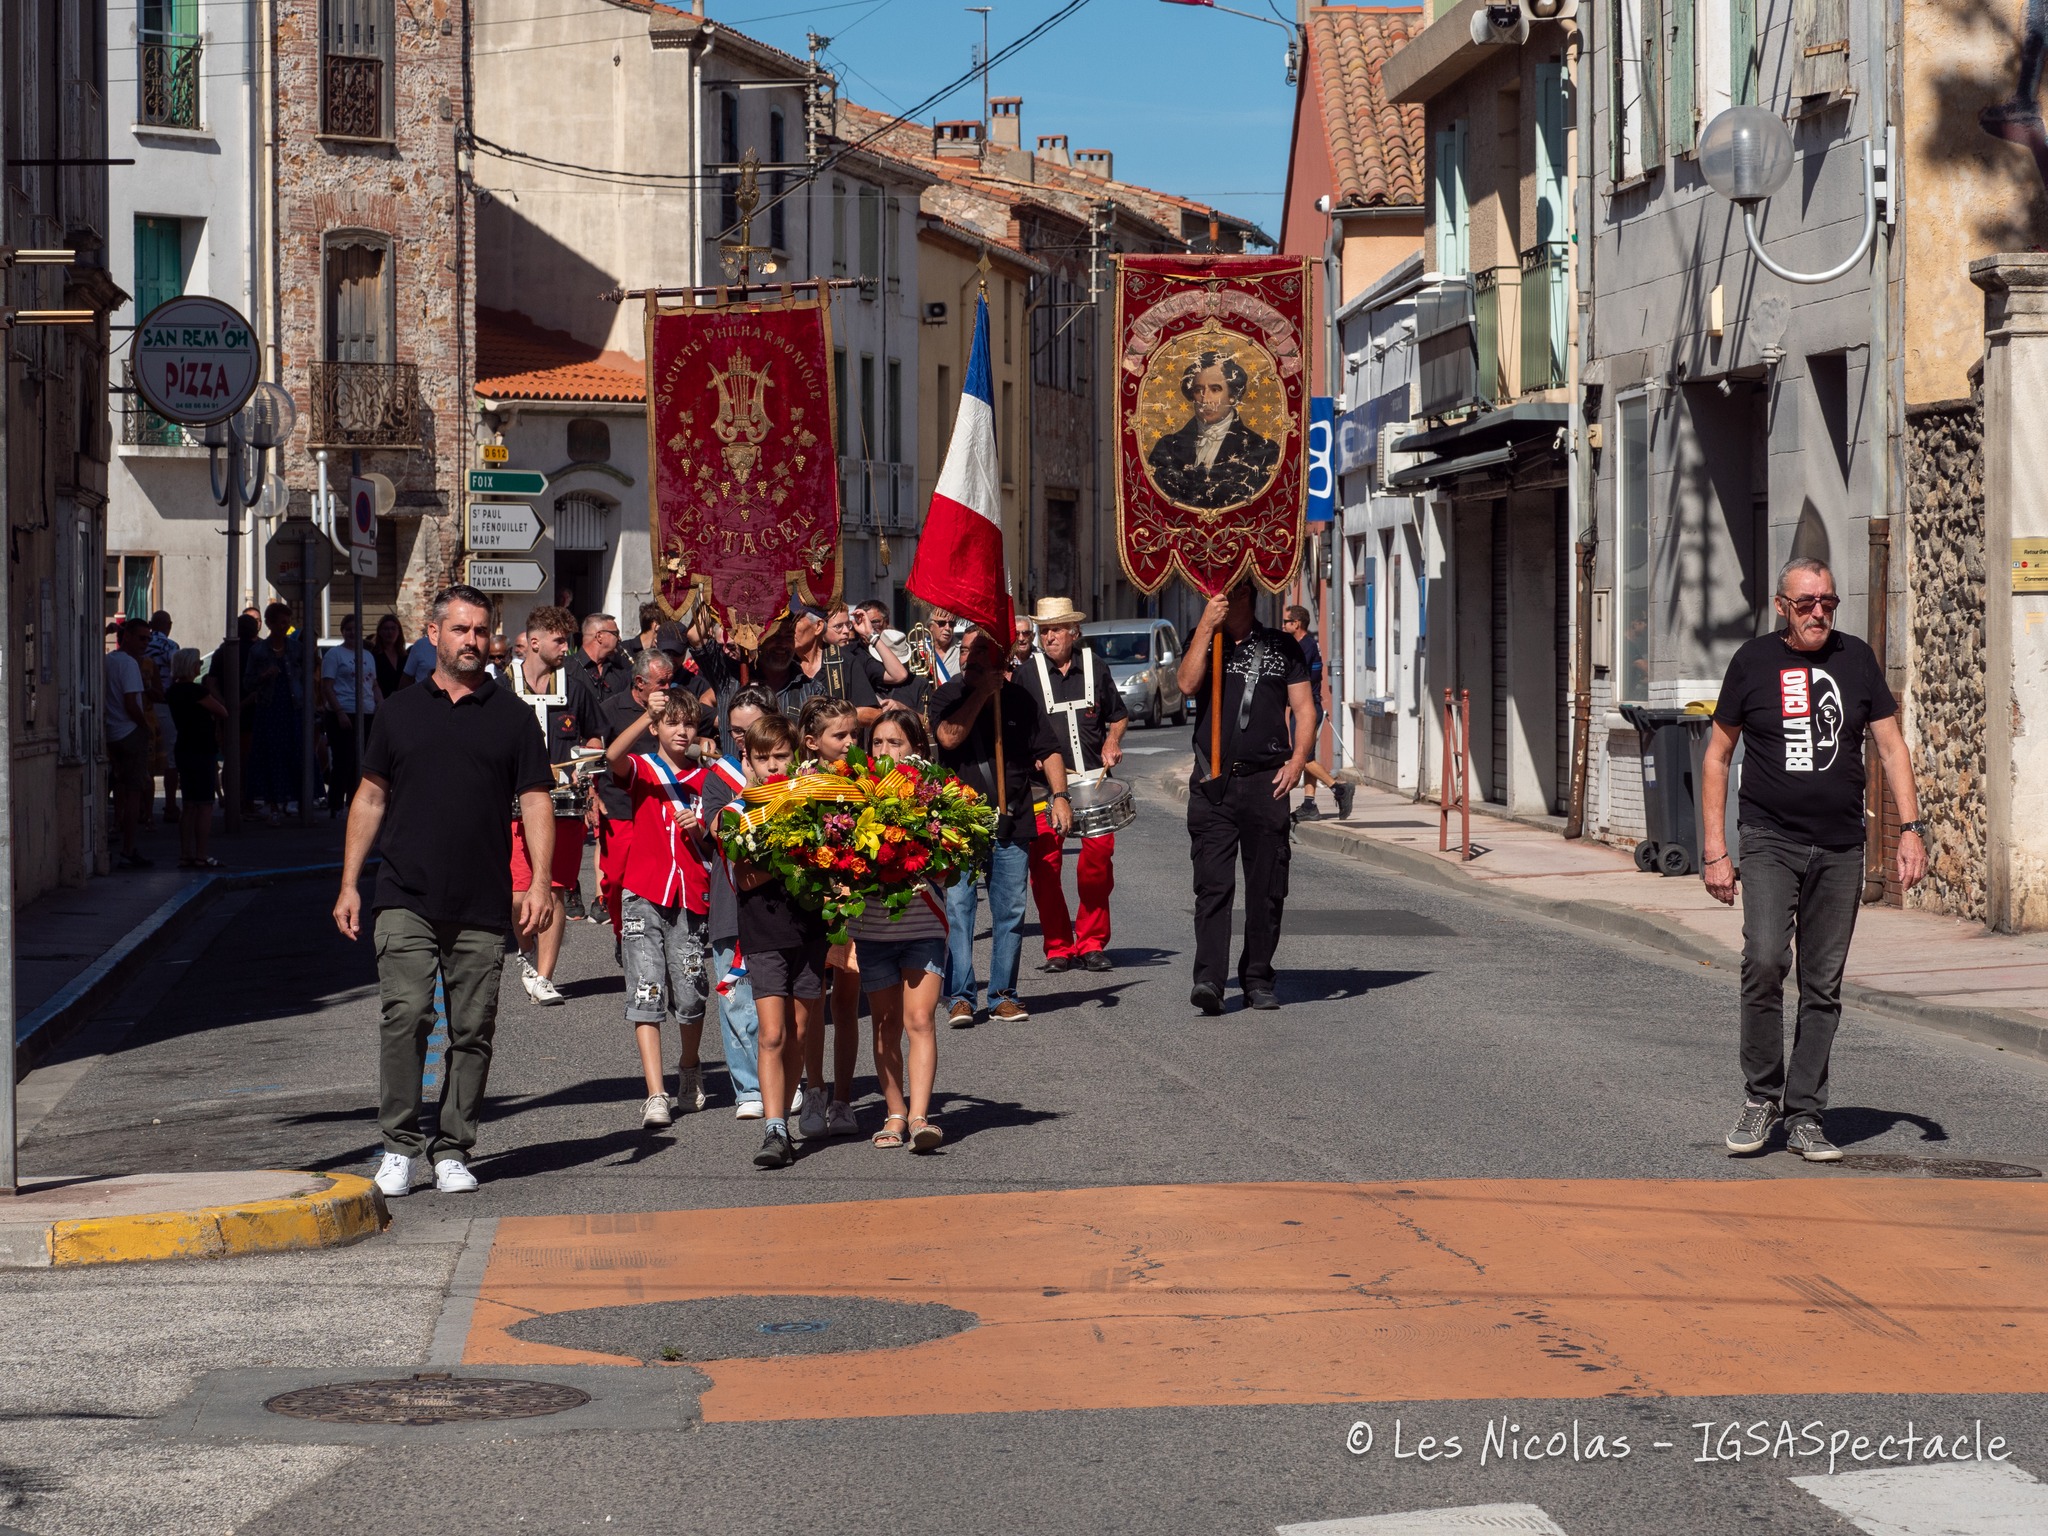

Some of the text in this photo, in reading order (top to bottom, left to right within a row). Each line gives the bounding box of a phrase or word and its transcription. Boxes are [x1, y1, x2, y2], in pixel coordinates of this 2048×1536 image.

[143, 329, 177, 348] SAN
[702, 325, 822, 401] PHILHARMONIQUE
[485, 448, 507, 459] D 612
[472, 475, 494, 488] FOIX
[482, 509, 502, 519] PAUL
[481, 522, 528, 533] FENOUILLET
[675, 503, 816, 555] ESTAGEL
[472, 535, 500, 545] MAURY
[472, 565, 505, 575] TUCHAN
[472, 577, 512, 587] TAUTAVEL
[1783, 670, 1813, 771] BELLA CIAO
